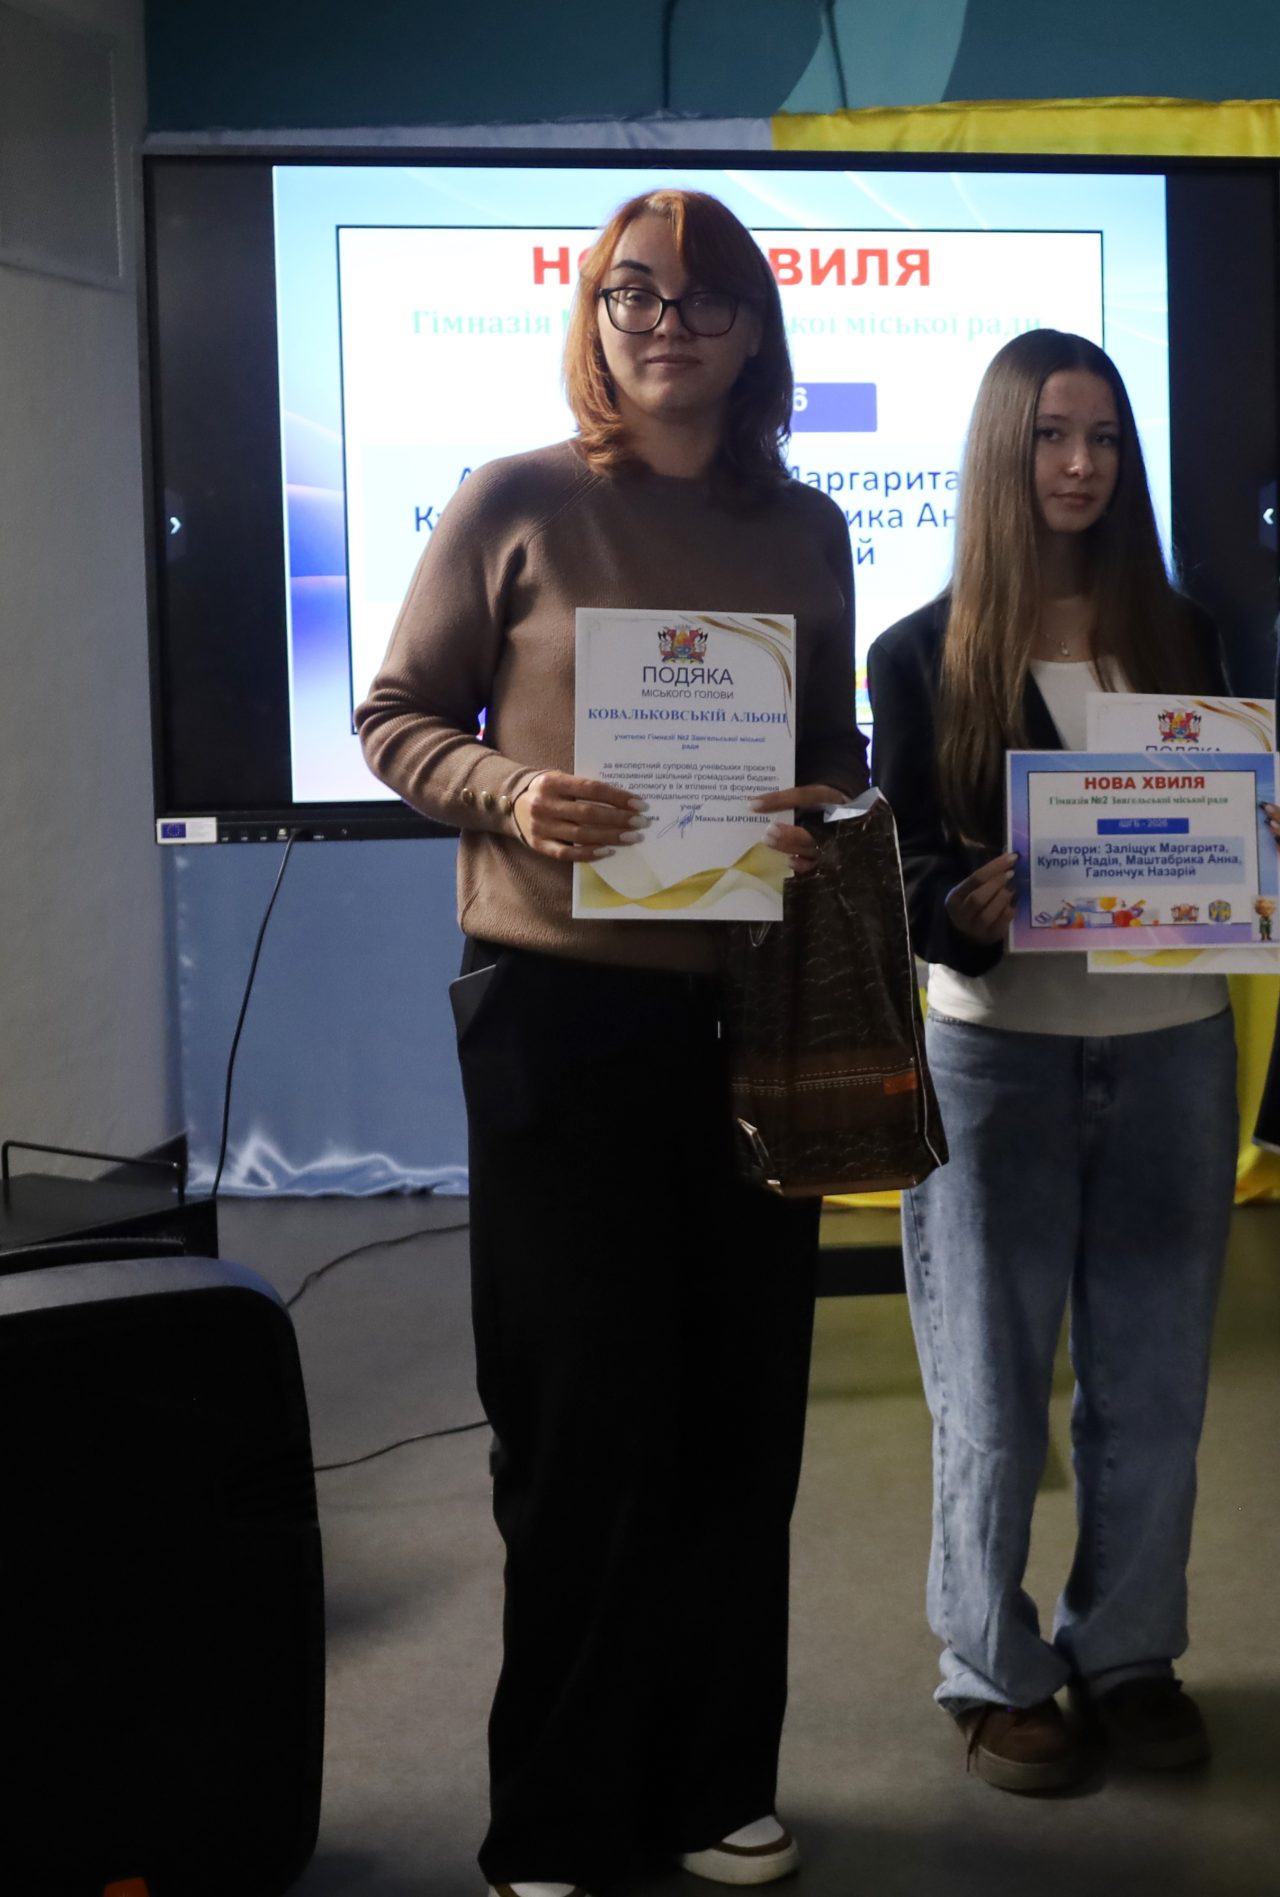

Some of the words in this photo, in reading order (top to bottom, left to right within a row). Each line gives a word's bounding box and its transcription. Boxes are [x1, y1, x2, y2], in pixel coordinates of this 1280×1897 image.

[768, 248, 931, 287] ВИЛЯ
[412, 309, 550, 335] Гімназія
[846, 312, 958, 336] міської
[791, 465, 960, 498] аргарита
[642, 666, 734, 687] ПОДЯКА
[641, 688, 692, 699] МІСЬКОГО
[694, 689, 734, 700] ГОЛОВИ
[588, 707, 726, 722] КОВАЛЬКОВСЬКІЙ
[730, 710, 787, 724] АЛЬОНІ
[614, 762, 660, 770] експертний
[662, 762, 698, 771] супровід
[655, 772, 692, 780] шкільний
[694, 773, 744, 782] громадський
[1084, 776, 1137, 790] НОВА
[1142, 776, 1205, 789] ХВИЛЯ
[628, 783, 667, 791] допомогу
[730, 784, 780, 792] формування
[639, 792, 699, 800] ідповідального
[1049, 797, 1088, 805] Гімназія
[726, 815, 771, 823] БОРОВЕЦЬ
[1050, 843, 1100, 855] Автори:
[1105, 843, 1156, 855] Заліщук
[1159, 843, 1229, 854] Маргарита,
[1037, 855, 1079, 868] Купрій
[1083, 855, 1122, 868] Надія,
[1126, 855, 1204, 867] Маштабрика
[1208, 855, 1243, 866] Анна,
[1085, 867, 1144, 879] Гапончук
[1147, 866, 1196, 878] Назарій
